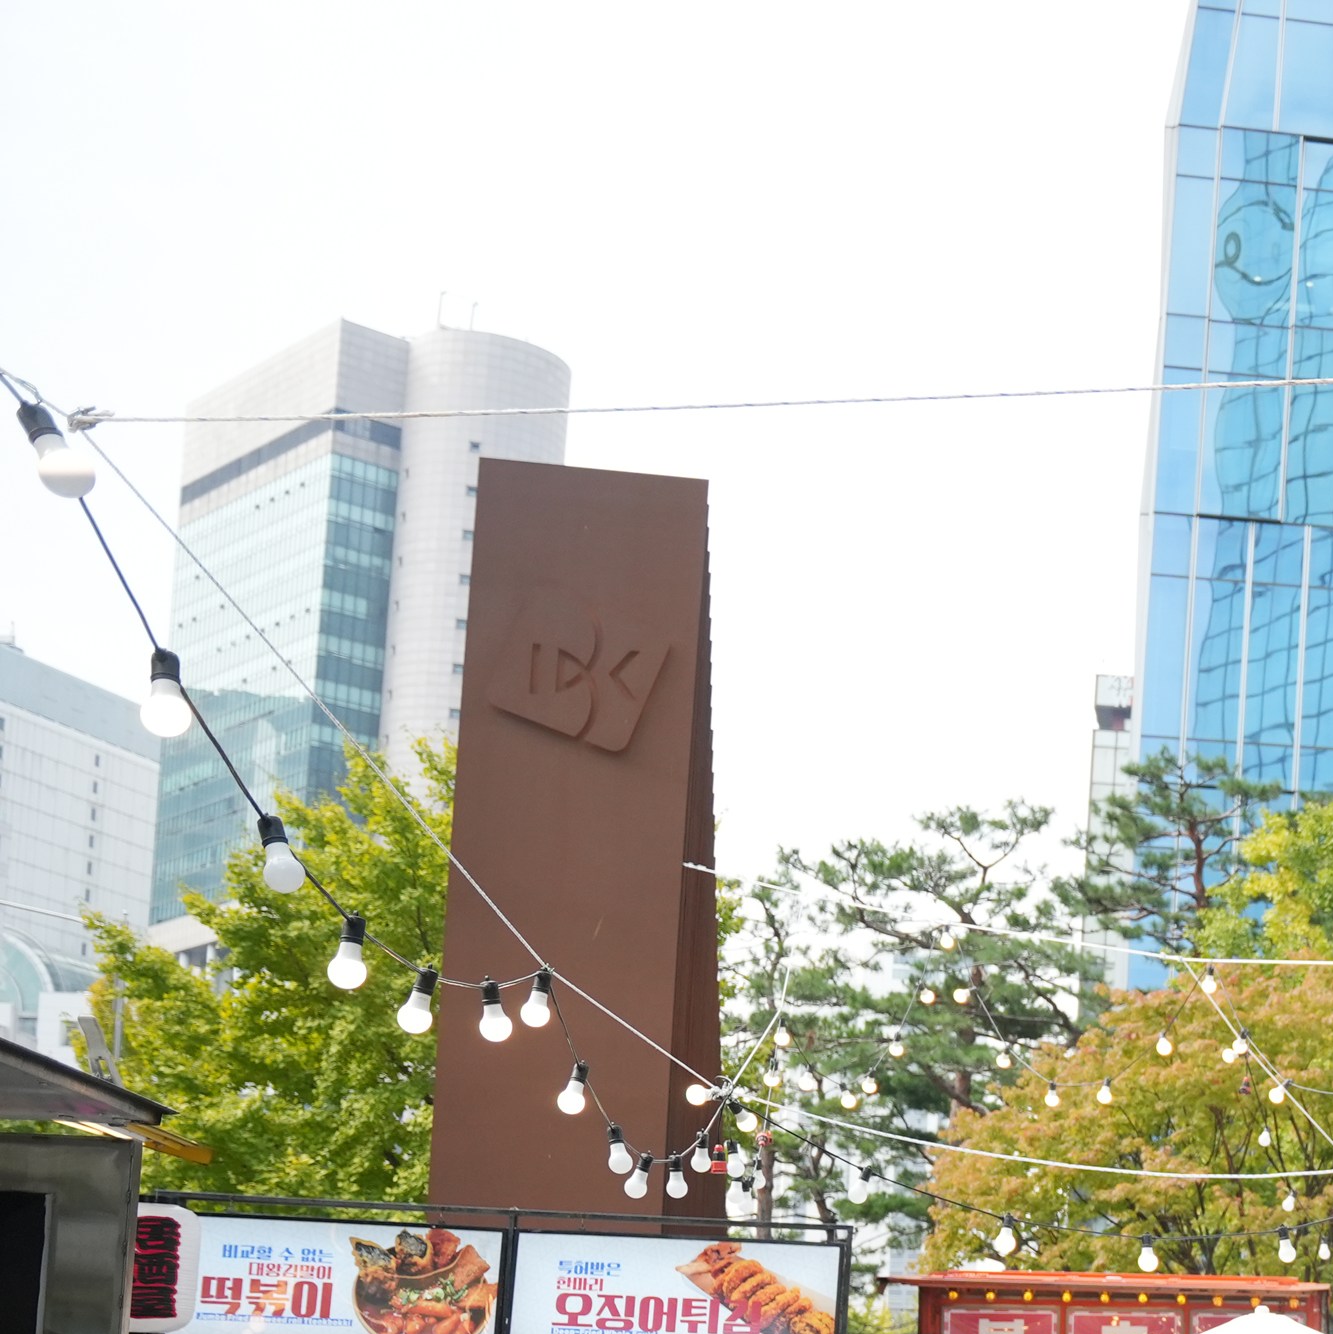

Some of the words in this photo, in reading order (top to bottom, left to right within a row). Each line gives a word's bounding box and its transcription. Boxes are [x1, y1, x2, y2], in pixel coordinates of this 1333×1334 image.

[222, 1244, 276, 1260] 비교할
[280, 1247, 294, 1261] 수
[301, 1247, 334, 1263] 없는
[249, 1262, 333, 1279] 대왕김말이
[558, 1260, 621, 1277] 특허받은
[556, 1277, 604, 1291] 한마리
[200, 1275, 334, 1319] 떡볶이
